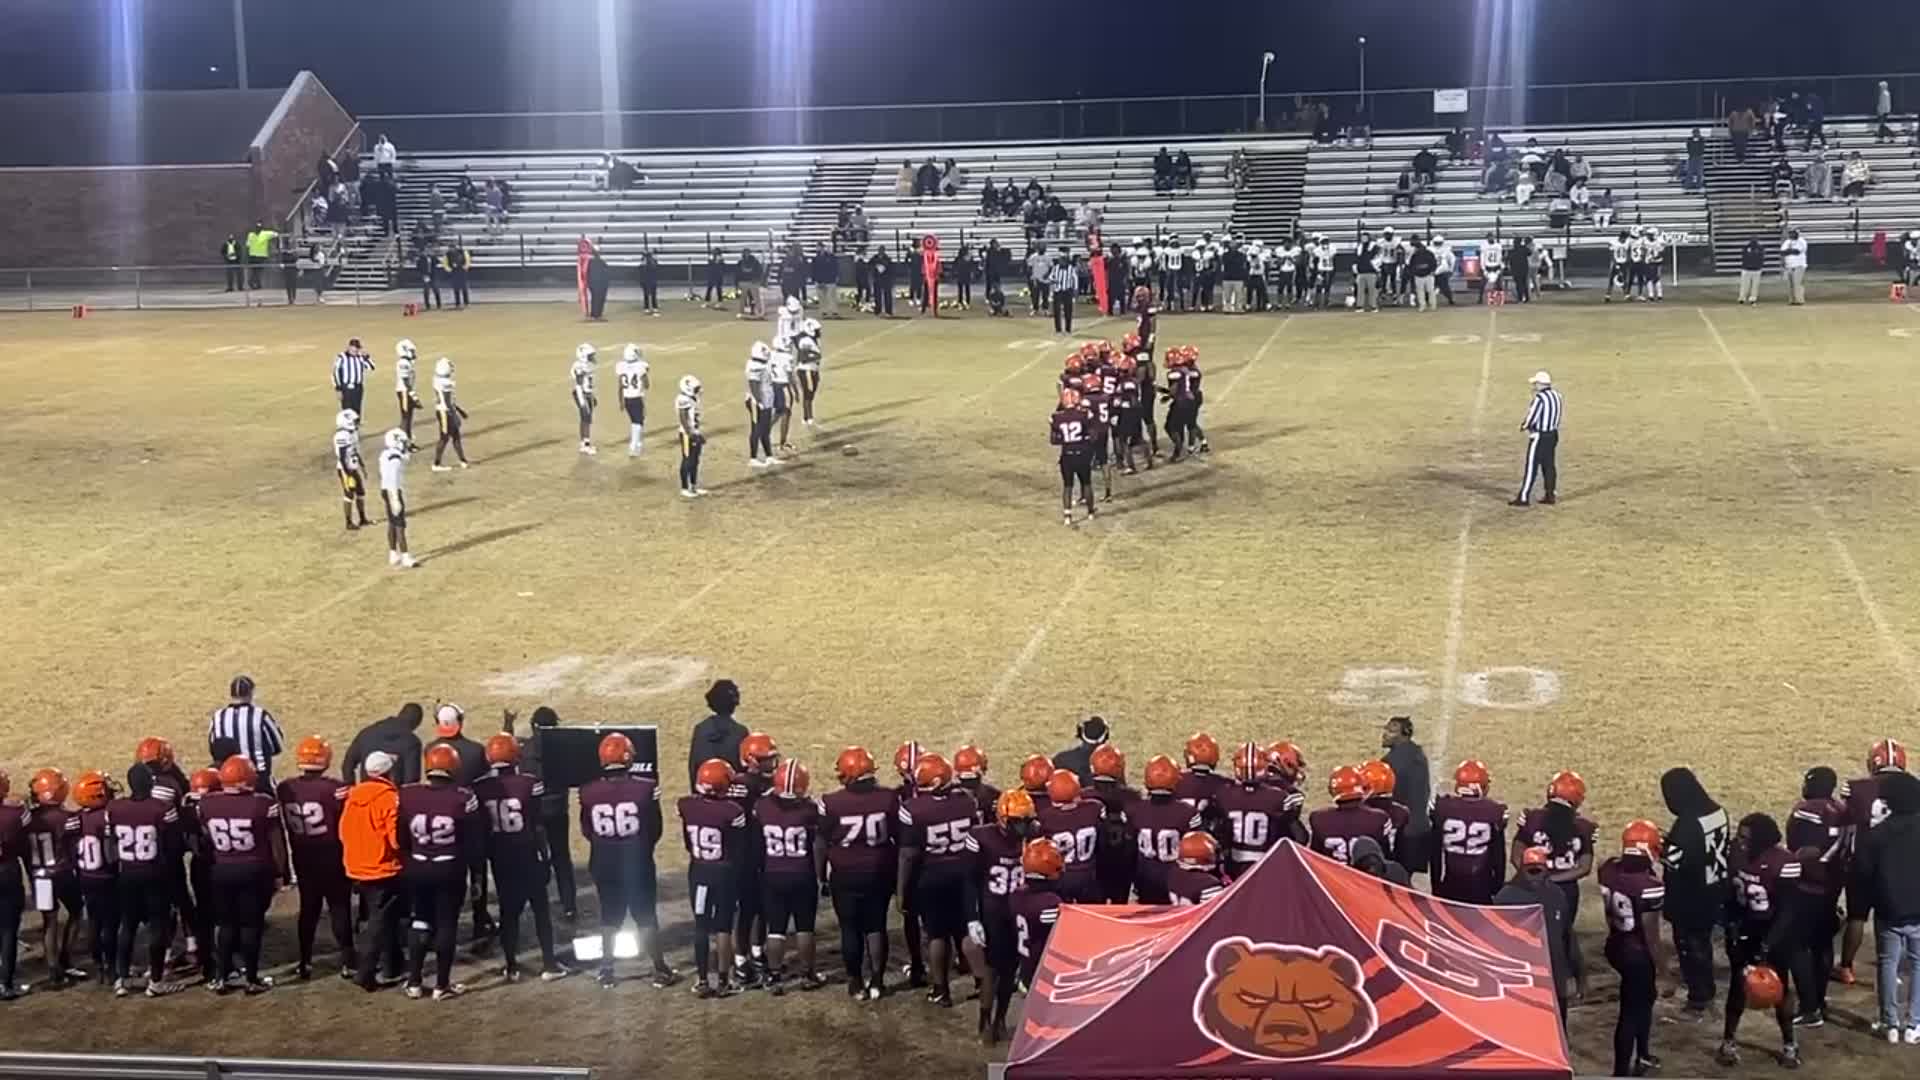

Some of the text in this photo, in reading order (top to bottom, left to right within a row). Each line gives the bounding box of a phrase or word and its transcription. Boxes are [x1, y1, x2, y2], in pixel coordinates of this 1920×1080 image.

[1059, 421, 1083, 442] 12
[1327, 664, 1561, 710] 50
[409, 813, 455, 845] 42
[484, 798, 524, 833] 16
[591, 802, 640, 838] 66
[839, 812, 886, 847] 70
[1228, 810, 1269, 846] 10
[115, 824, 158, 861] 28
[207, 818, 255, 851] 65
[686, 824, 723, 860] 19
[925, 818, 972, 854] 55
[1137, 828, 1180, 862] 40
[1443, 818, 1491, 855] 22
